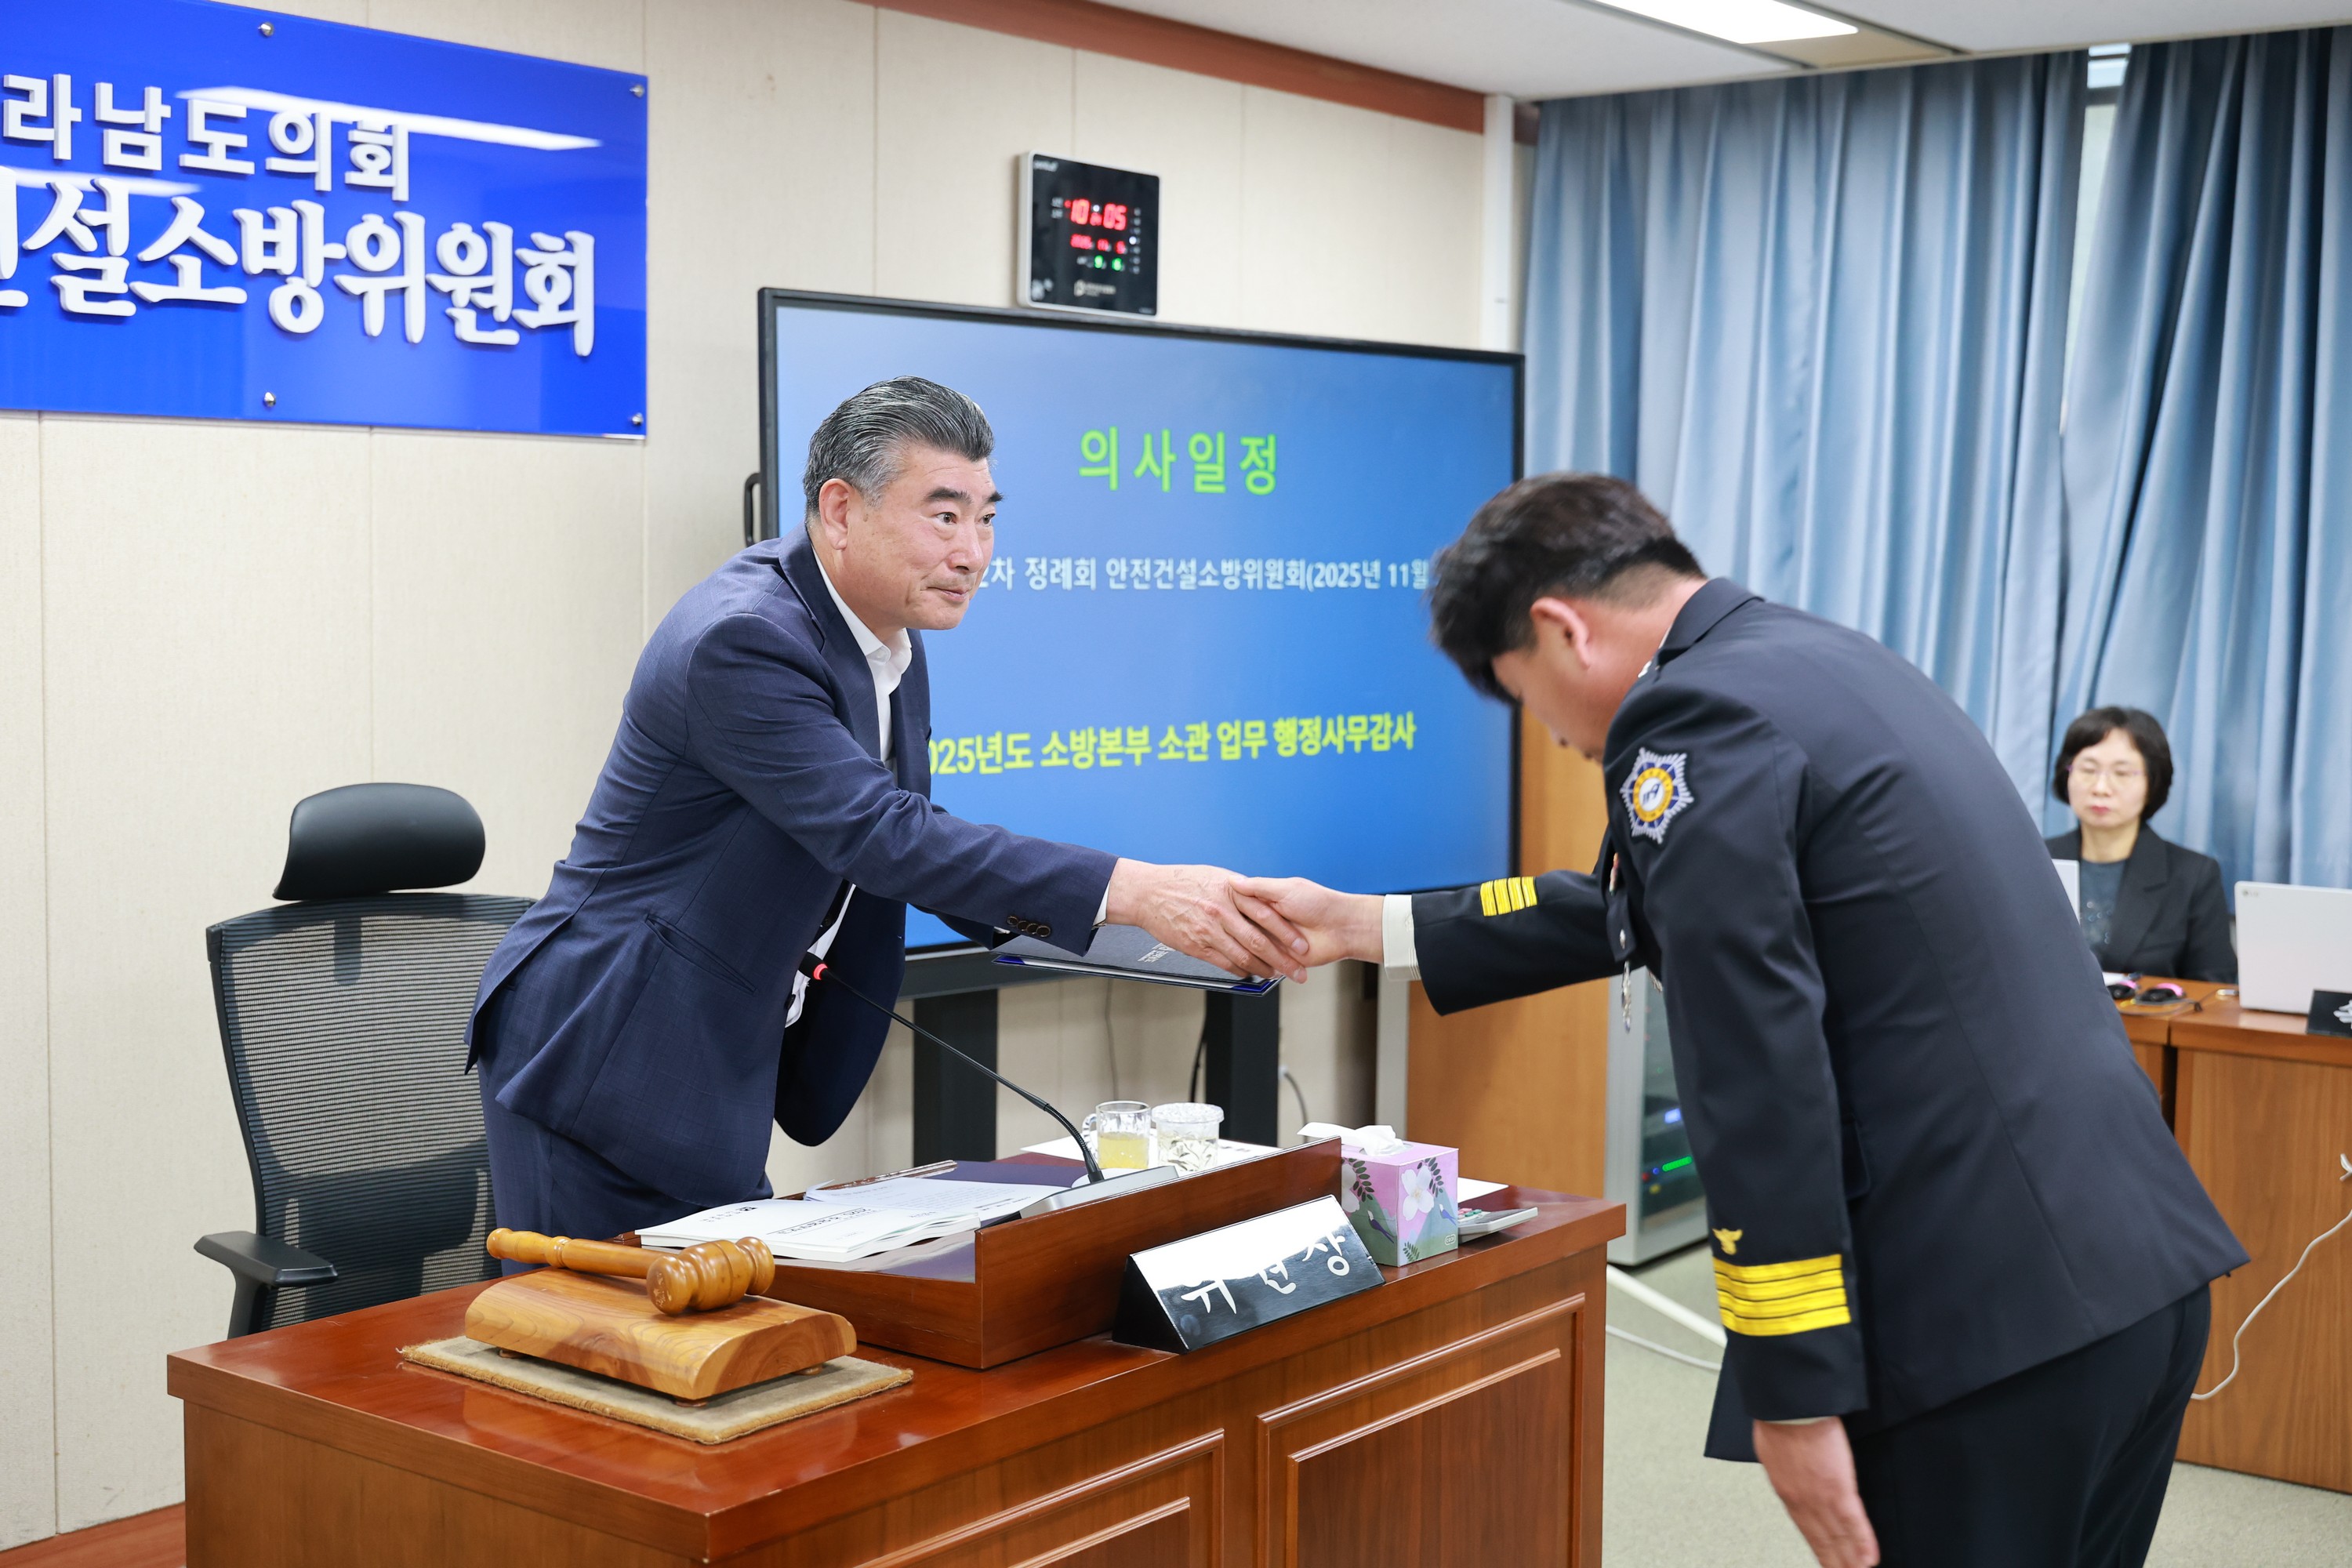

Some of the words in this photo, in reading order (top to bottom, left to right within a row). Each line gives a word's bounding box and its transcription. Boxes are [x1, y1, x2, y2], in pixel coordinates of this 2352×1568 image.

[2, 73, 410, 201] 라남도의회
[1025, 556, 1096, 591] 정례회
[1040, 724, 1152, 770] 소방본부
[1157, 720, 1212, 762] 소관
[1216, 718, 1269, 760] 업무
[1272, 710, 1417, 757] 행정사무감사
